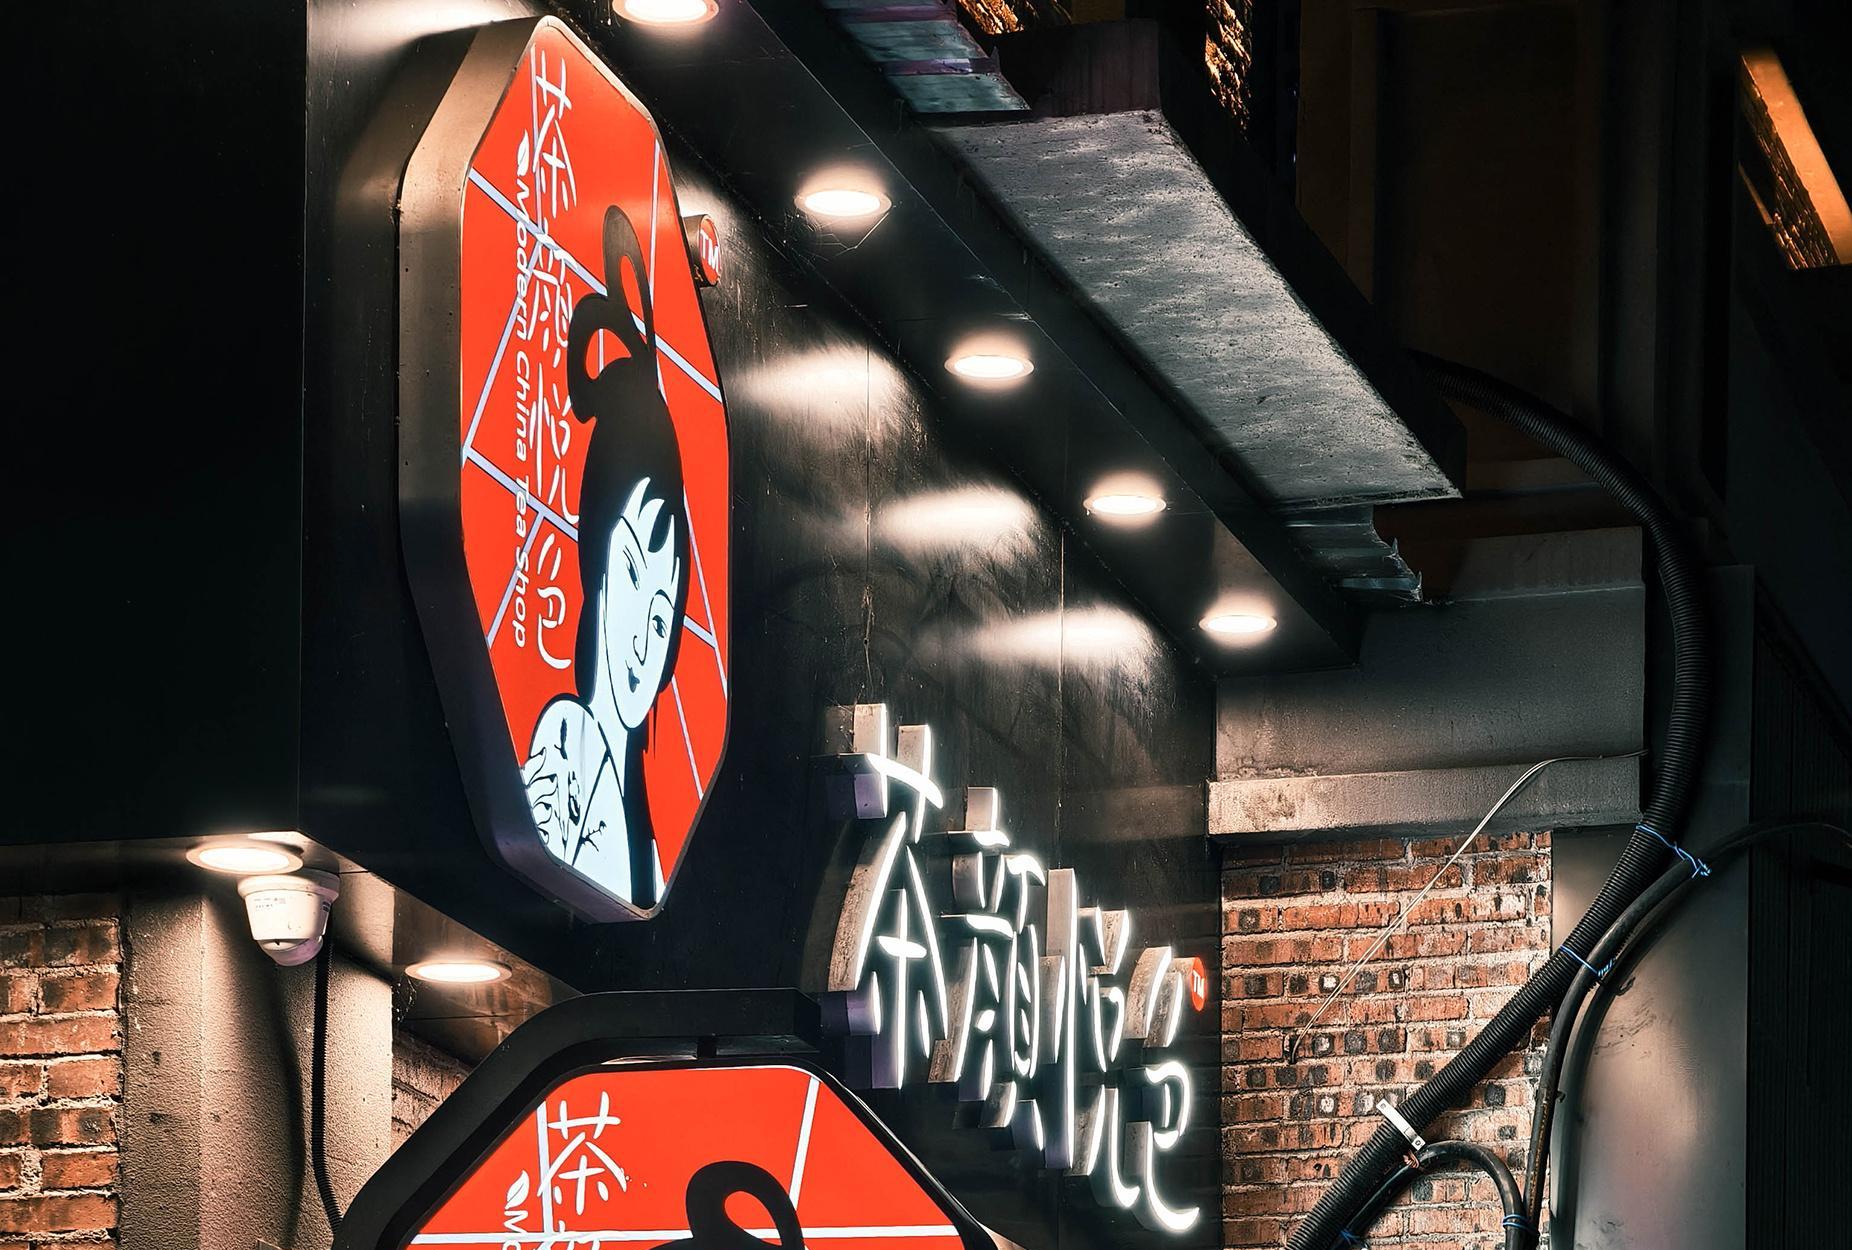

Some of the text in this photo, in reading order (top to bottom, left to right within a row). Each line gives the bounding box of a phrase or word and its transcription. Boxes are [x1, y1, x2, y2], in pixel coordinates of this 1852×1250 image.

[700, 229, 719, 274] TM
[512, 178, 530, 648] Modern China Tea Shop
